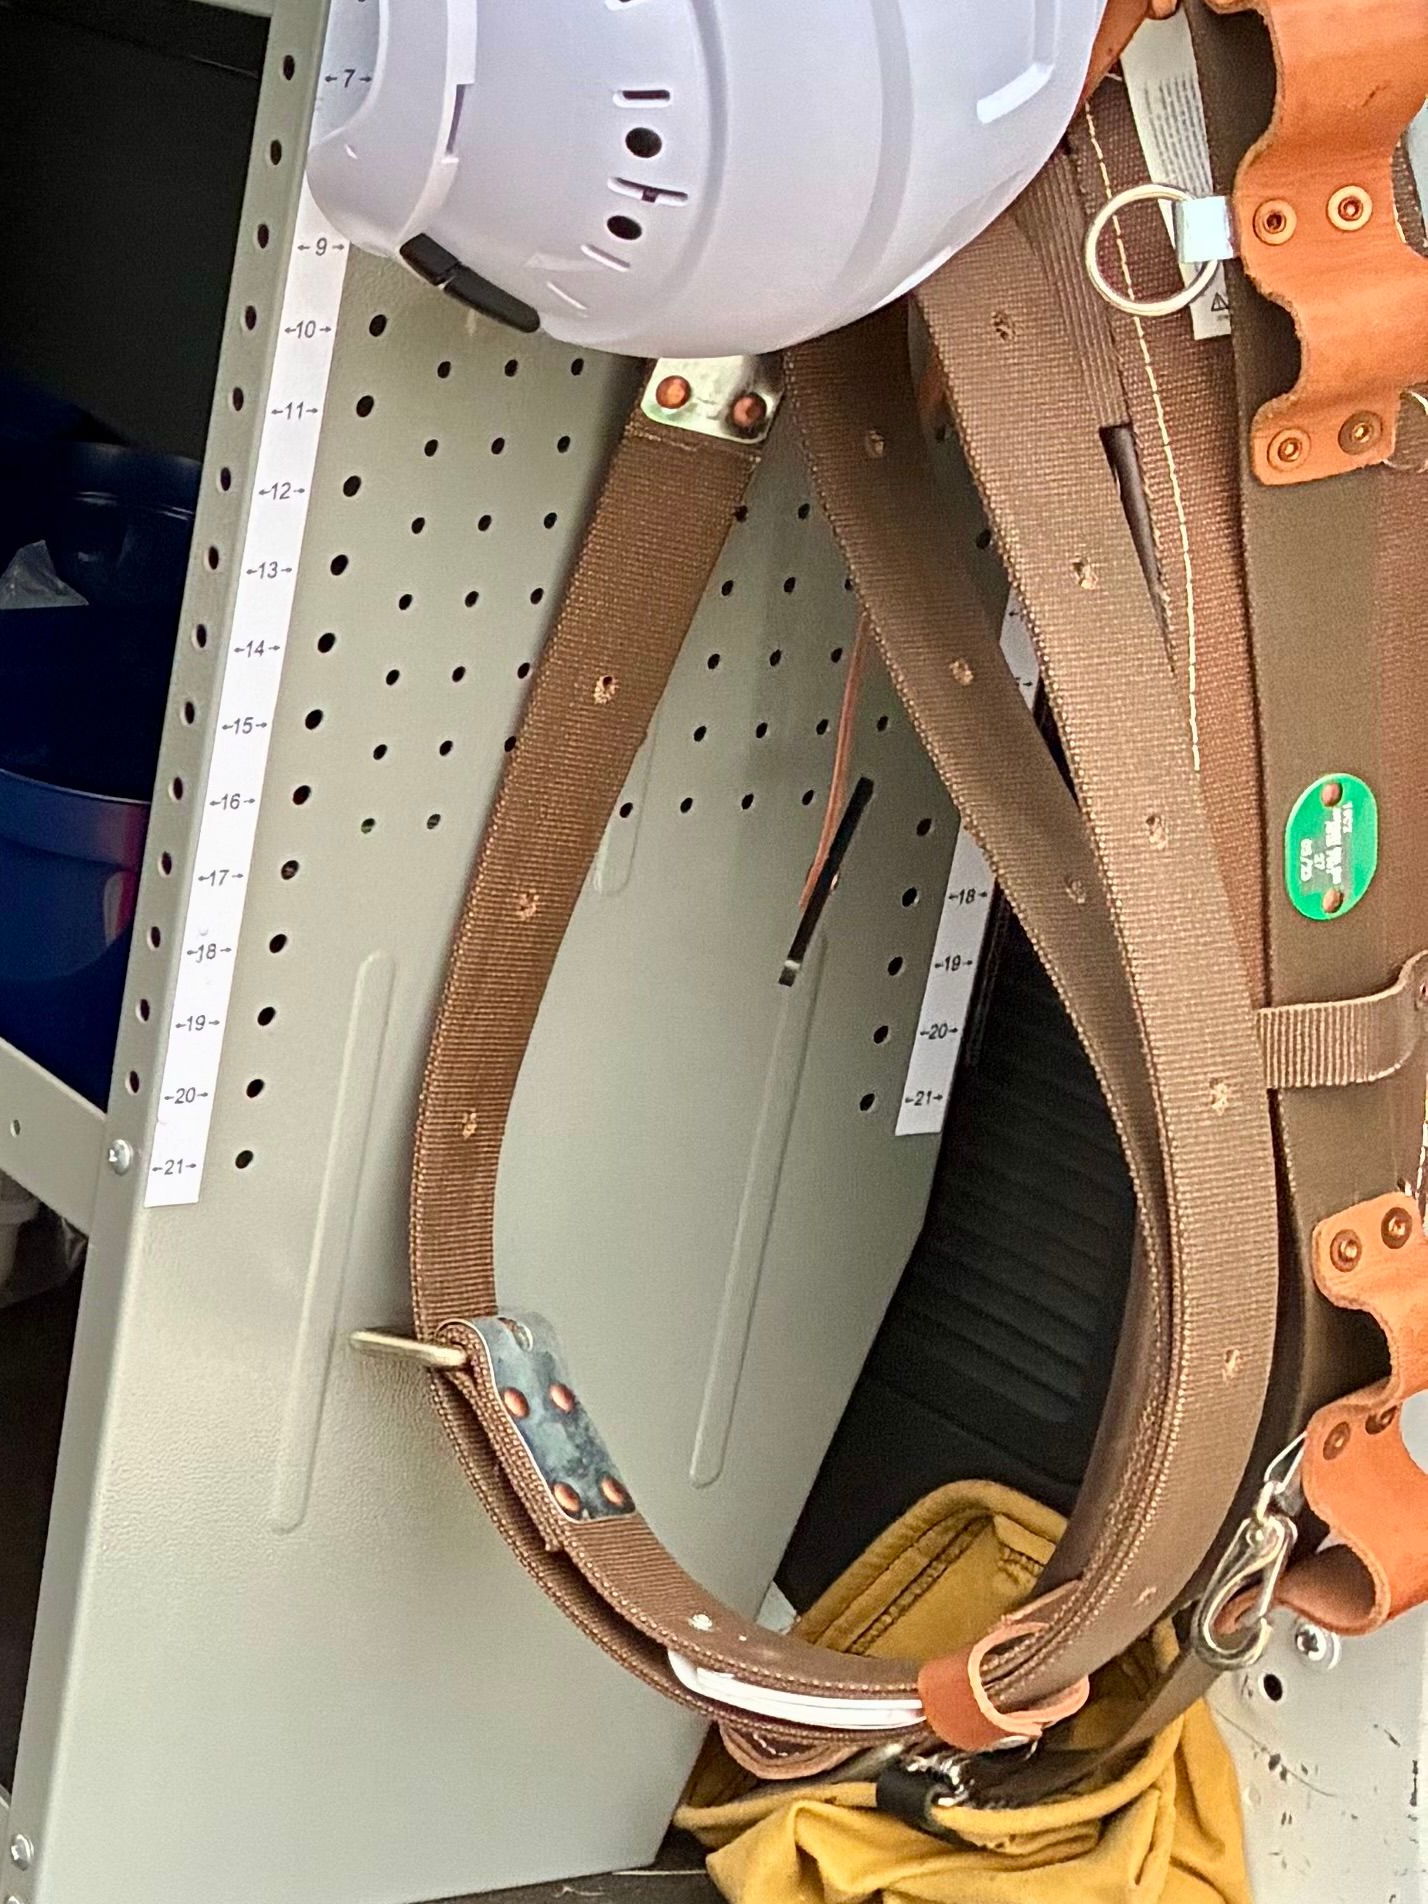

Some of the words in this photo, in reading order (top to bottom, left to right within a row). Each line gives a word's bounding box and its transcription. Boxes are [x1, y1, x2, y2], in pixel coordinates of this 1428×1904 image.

[345, 69, 355, 88] 7
[316, 238, 327, 256] 9
[297, 321, 315, 338] 10
[286, 402, 303, 419] 11
[272, 482, 291, 499] 12
[259, 562, 277, 578] 13
[247, 640, 264, 657] 14
[235, 717, 253, 734] 15
[222, 794, 240, 809] 16
[210, 870, 229, 886] 17
[957, 888, 976, 904] 18
[199, 944, 216, 961] 18
[945, 955, 961, 971] 19
[188, 1015, 205, 1030] 19
[928, 1023, 948, 1039] 20
[175, 1087, 195, 1104] 20
[914, 1091, 932, 1106] 21
[165, 1159, 183, 1175] 21
